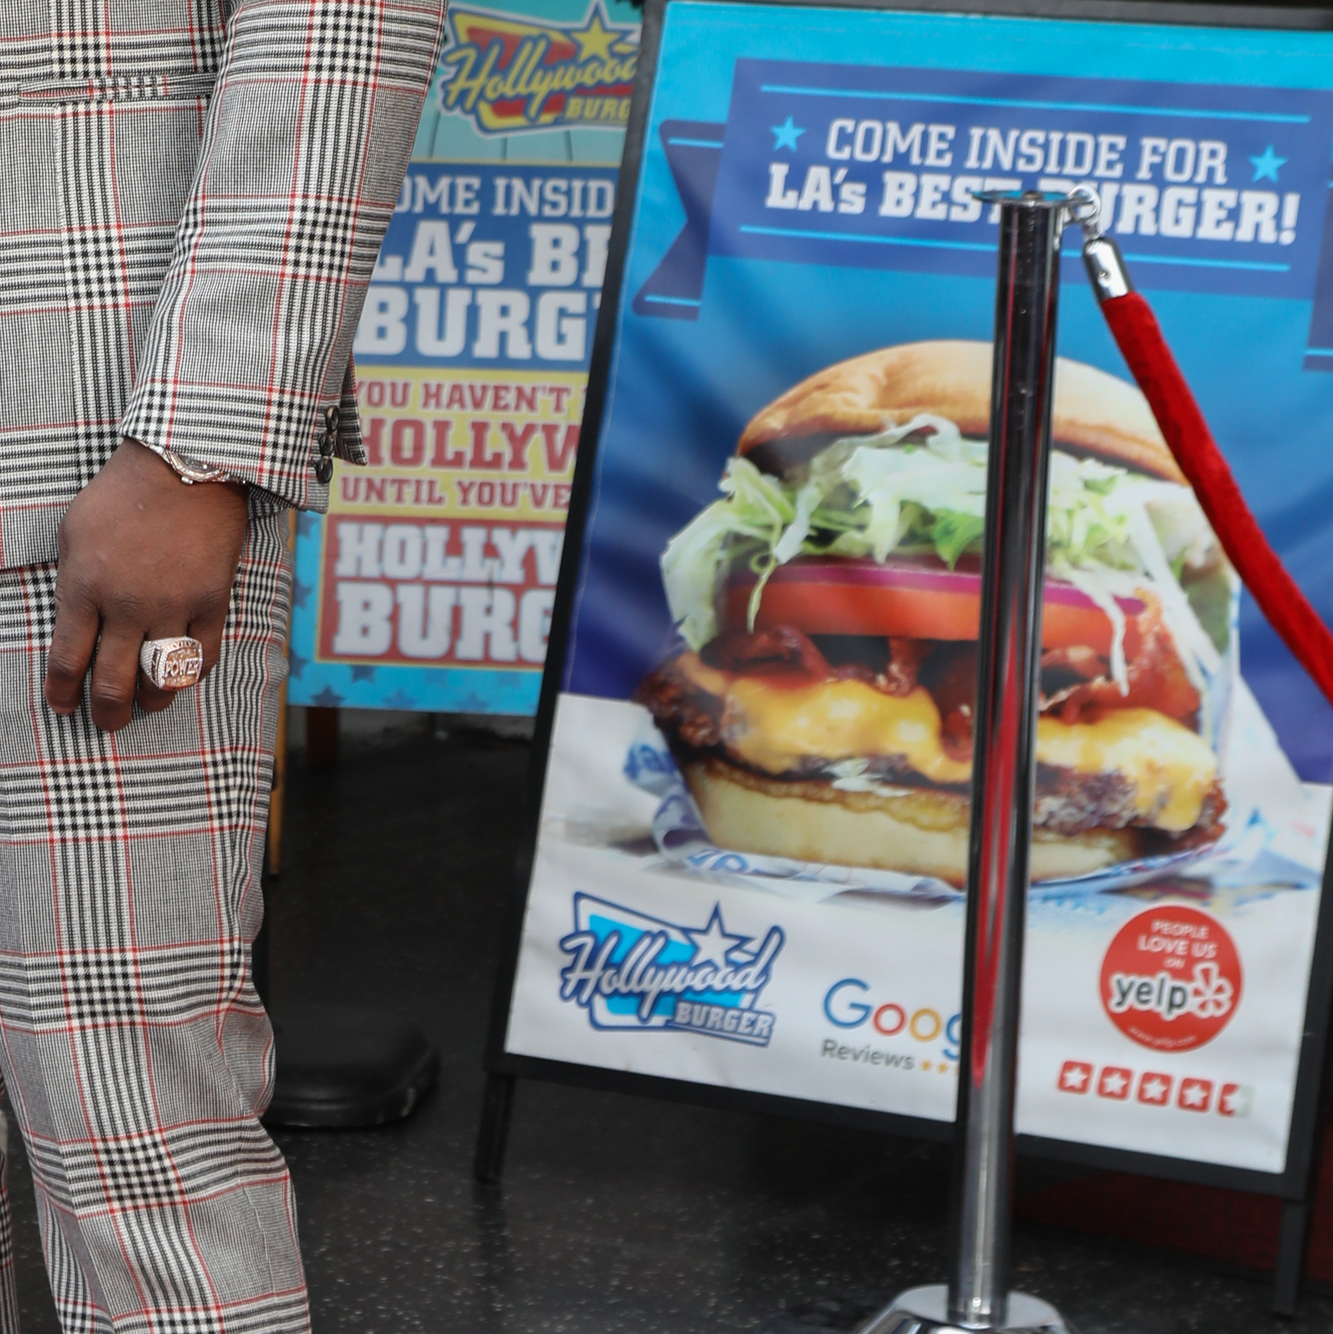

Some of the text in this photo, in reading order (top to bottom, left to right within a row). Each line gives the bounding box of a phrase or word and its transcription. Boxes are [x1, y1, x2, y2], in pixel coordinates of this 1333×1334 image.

[826, 118, 1229, 185] COME INSIDE FOR
[766, 163, 867, 215] LA's
[353, 287, 603, 362] BURG
[422, 381, 571, 414] HAVEN'T
[341, 476, 571, 509] UNTIL YOU'VE
[164, 657, 200, 678] POWER
[1137, 934, 1218, 959] LOVE US
[1151, 919, 1209, 940] PEOPLE
[560, 926, 785, 1024] Hollywood
[1115, 976, 1189, 1016] yelp
[674, 1001, 776, 1038] BURGER
[822, 1039, 916, 1070] Reviews
